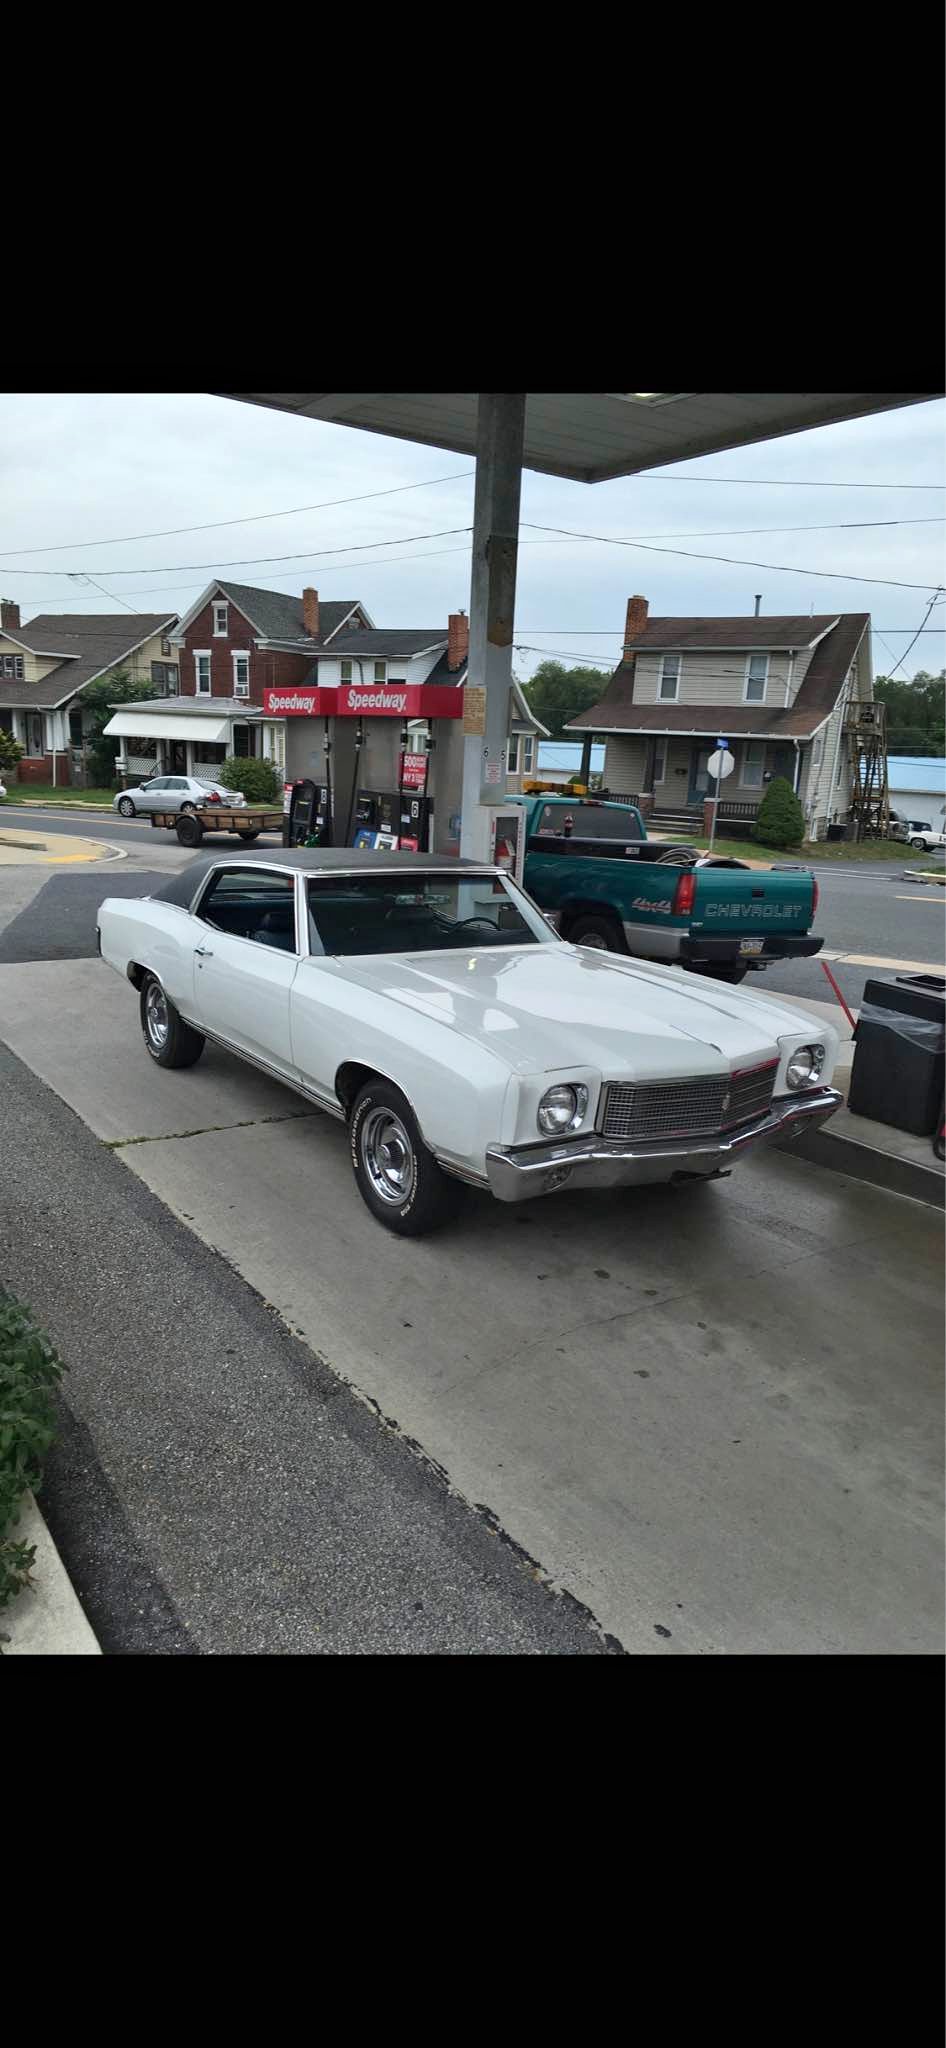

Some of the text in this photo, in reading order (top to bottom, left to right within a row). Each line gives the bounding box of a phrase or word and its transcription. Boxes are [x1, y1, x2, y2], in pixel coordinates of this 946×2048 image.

[268, 693, 315, 713] Speedway
[347, 689, 406, 712] Speedway
[412, 802, 418, 817] 6
[704, 903, 802, 918] CHEVROLET
